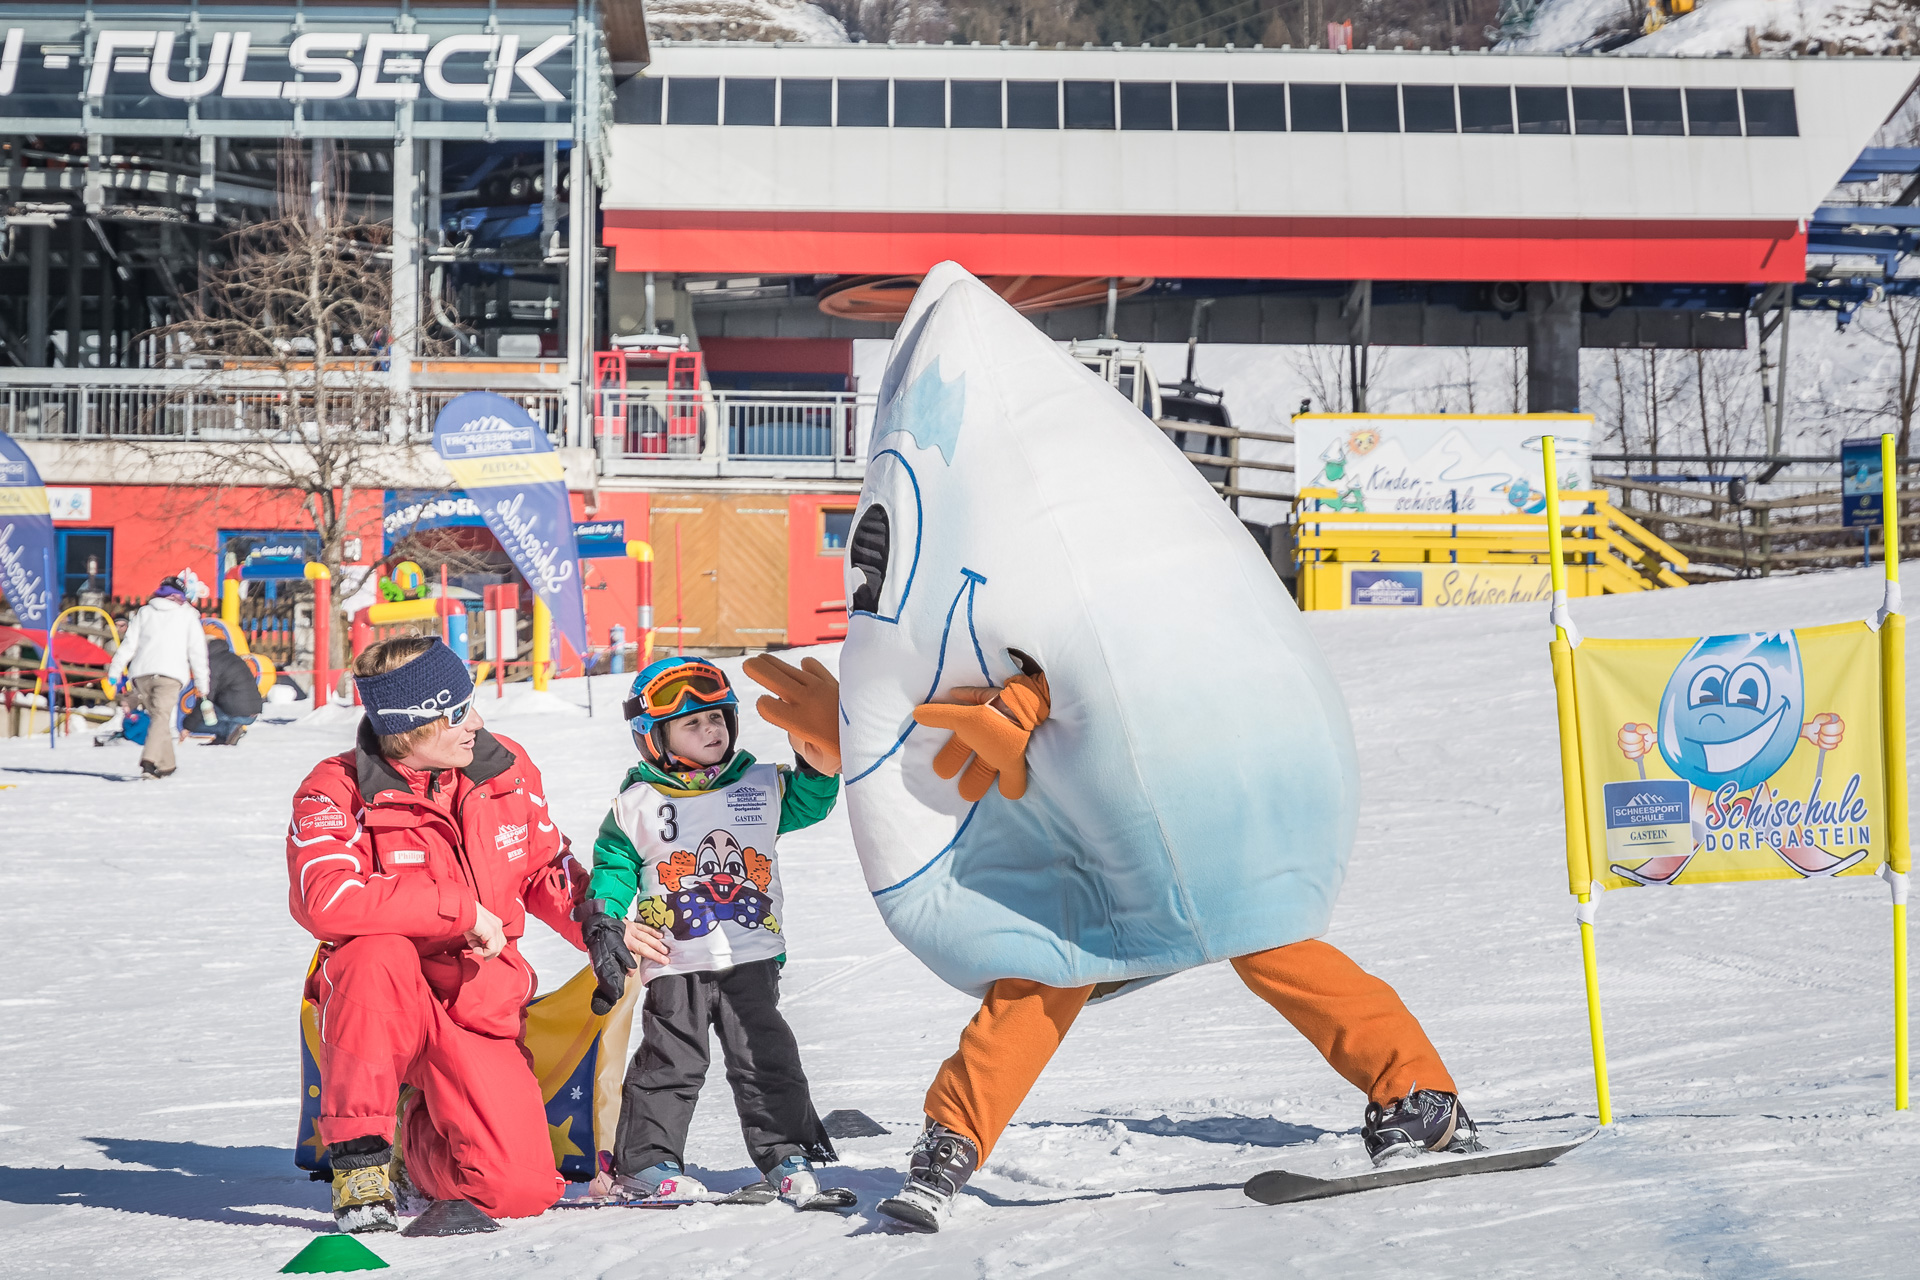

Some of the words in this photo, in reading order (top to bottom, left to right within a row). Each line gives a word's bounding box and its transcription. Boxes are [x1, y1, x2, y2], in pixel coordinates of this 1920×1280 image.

[1371, 550, 1380, 562] 2
[1705, 773, 1868, 831] Schischule
[1615, 805, 1680, 816] SCHNEESPORT
[657, 802, 679, 843] 3
[734, 814, 763, 823] GASTEIN
[1630, 813, 1665, 823] SCHULE
[1630, 829, 1668, 841] GASTEIN
[1706, 826, 1870, 851] DORFGASTEIN
